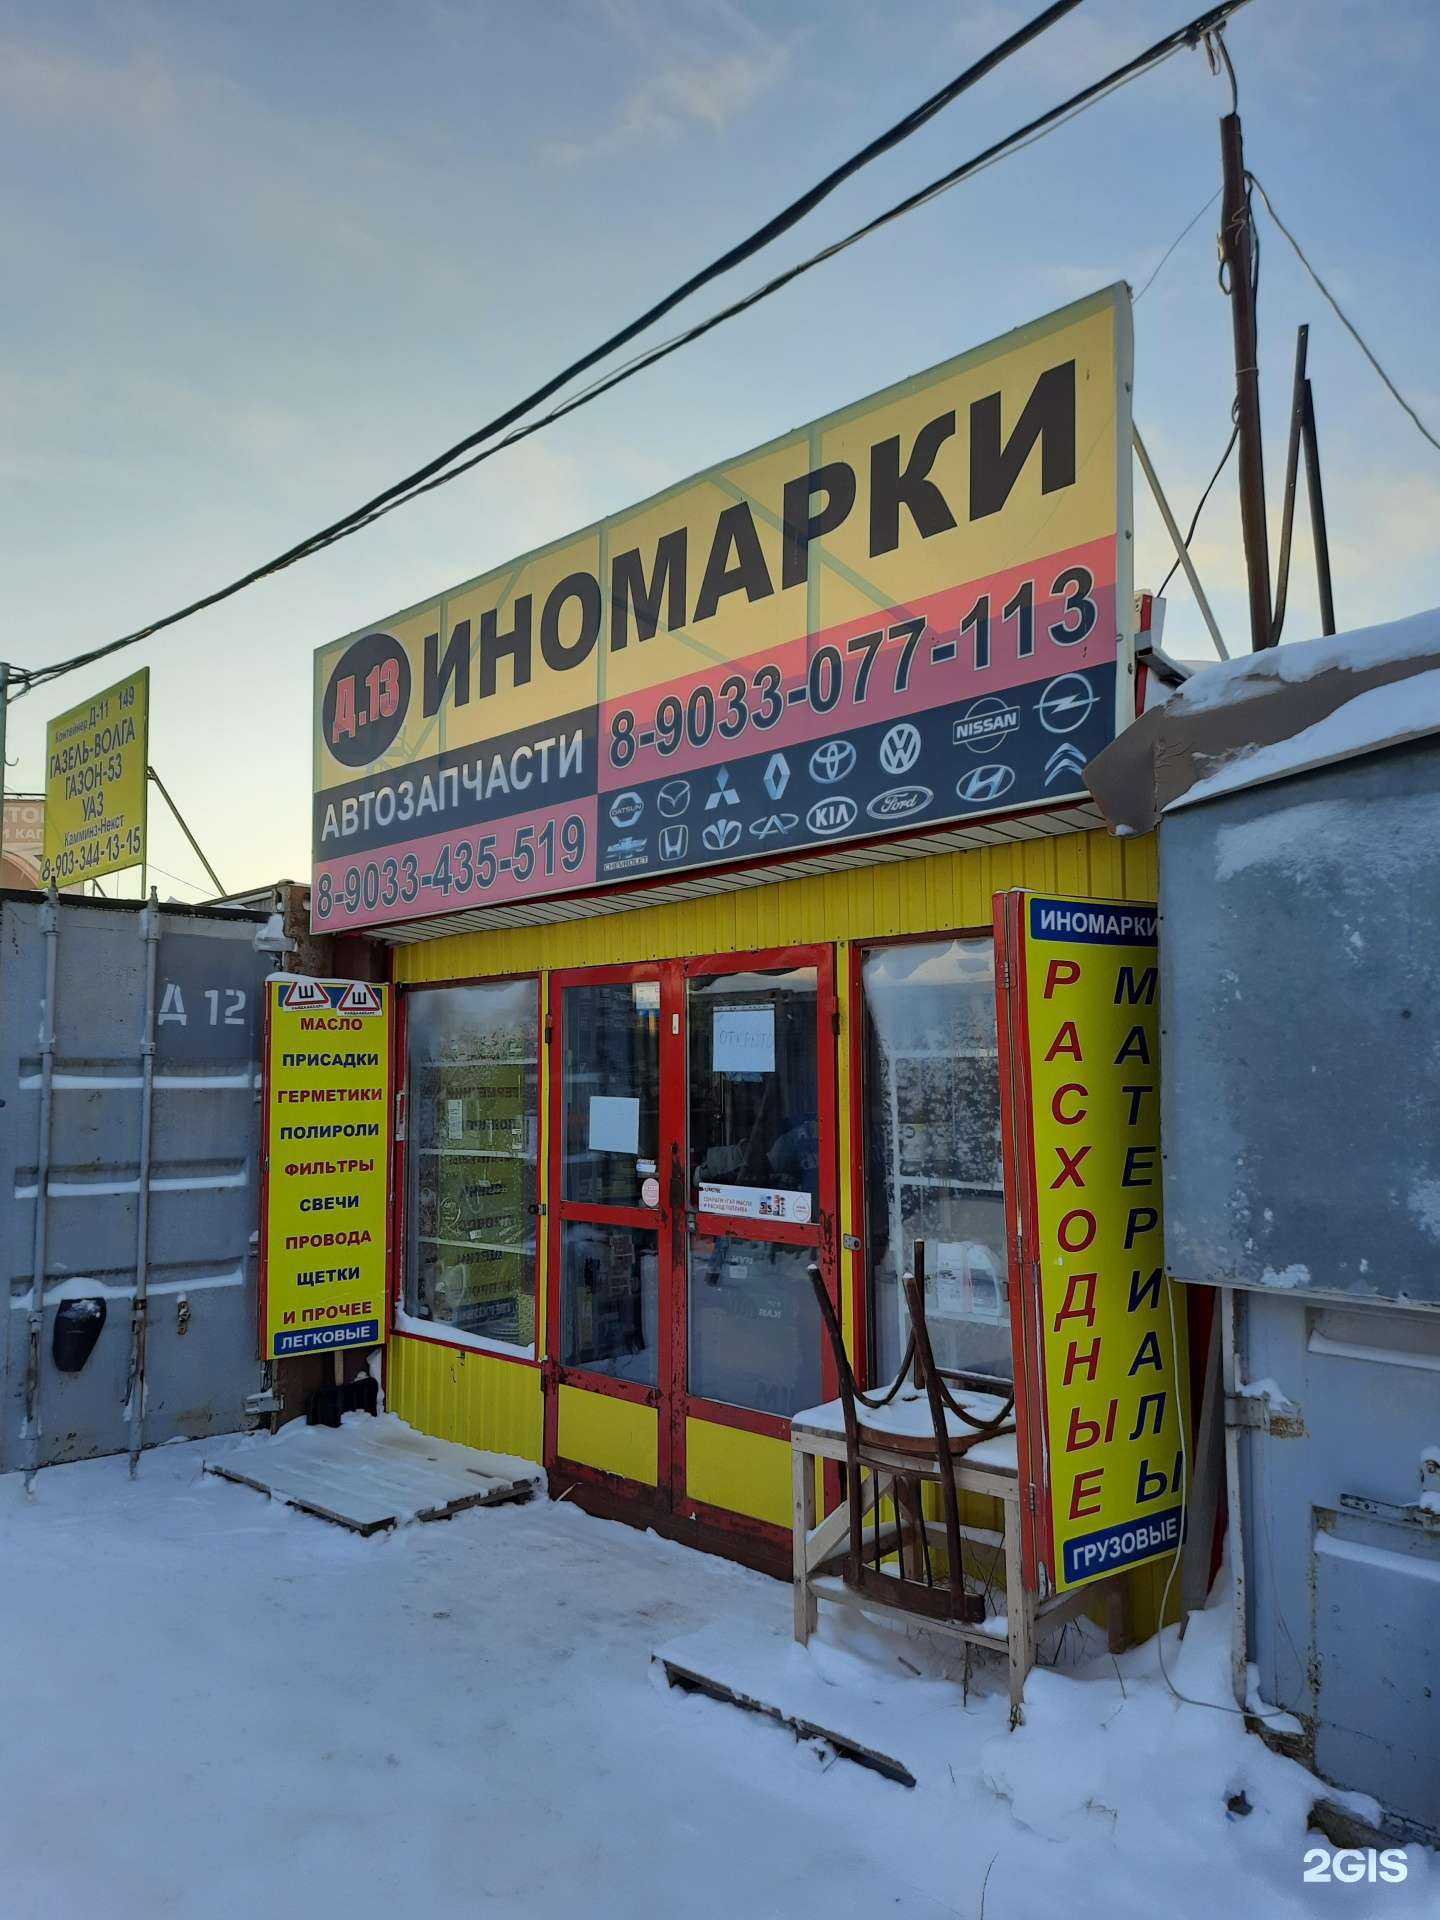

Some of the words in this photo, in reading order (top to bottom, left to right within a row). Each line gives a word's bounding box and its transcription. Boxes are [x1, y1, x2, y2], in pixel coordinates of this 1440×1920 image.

[423, 359, 1075, 718] ИНОМАРКИ
[608, 565, 1098, 770] 8-9033-077-113
[332, 657, 400, 743] Д.13
[956, 712, 1017, 739] NISSAN
[50, 716, 135, 779] ГАЗЕЛЬ-ВОЛГА
[65, 753, 122, 800] ГАЗОН-53
[321, 729, 583, 842] АВТОЗАПЧАСТИ
[82, 791, 104, 822] УАЗ
[815, 804, 849, 827] KIA
[881, 793, 918, 813] Ford
[64, 815, 124, 847] Камминз-Некст
[41, 826, 141, 881] 8-903-344-13-15
[316, 815, 586, 919] 8-9033-435-519
[158, 983, 187, 1026] Д
[204, 989, 246, 1026] 12
[298, 985, 314, 998] Ш
[352, 992, 367, 1004] Ш
[300, 1017, 363, 1031] МАСЛО
[282, 1053, 379, 1068] ПРИСАДКИ
[277, 1088, 383, 1104] ГЕРМЕТИКИ
[280, 1124, 379, 1140] ПОЛИРОЛИ
[284, 1159, 374, 1176] ФИЛЬТРЫ
[300, 1195, 359, 1212] СВЕЧИ
[286, 1230, 372, 1249] ПРОВОДА
[1043, 959, 1119, 1521] РАСХОДНЫЕ
[1113, 966, 1184, 1504] МАТЕРИАЛЫ
[297, 1267, 360, 1287] ЩЕТКИ
[283, 1311, 295, 1325] И
[302, 1301, 372, 1322] ПРОЧЕЕ
[281, 1326, 370, 1350] ЛЕГКОВЫЕ
[1072, 1517, 1178, 1571] ГРУЗОВЫЕ
